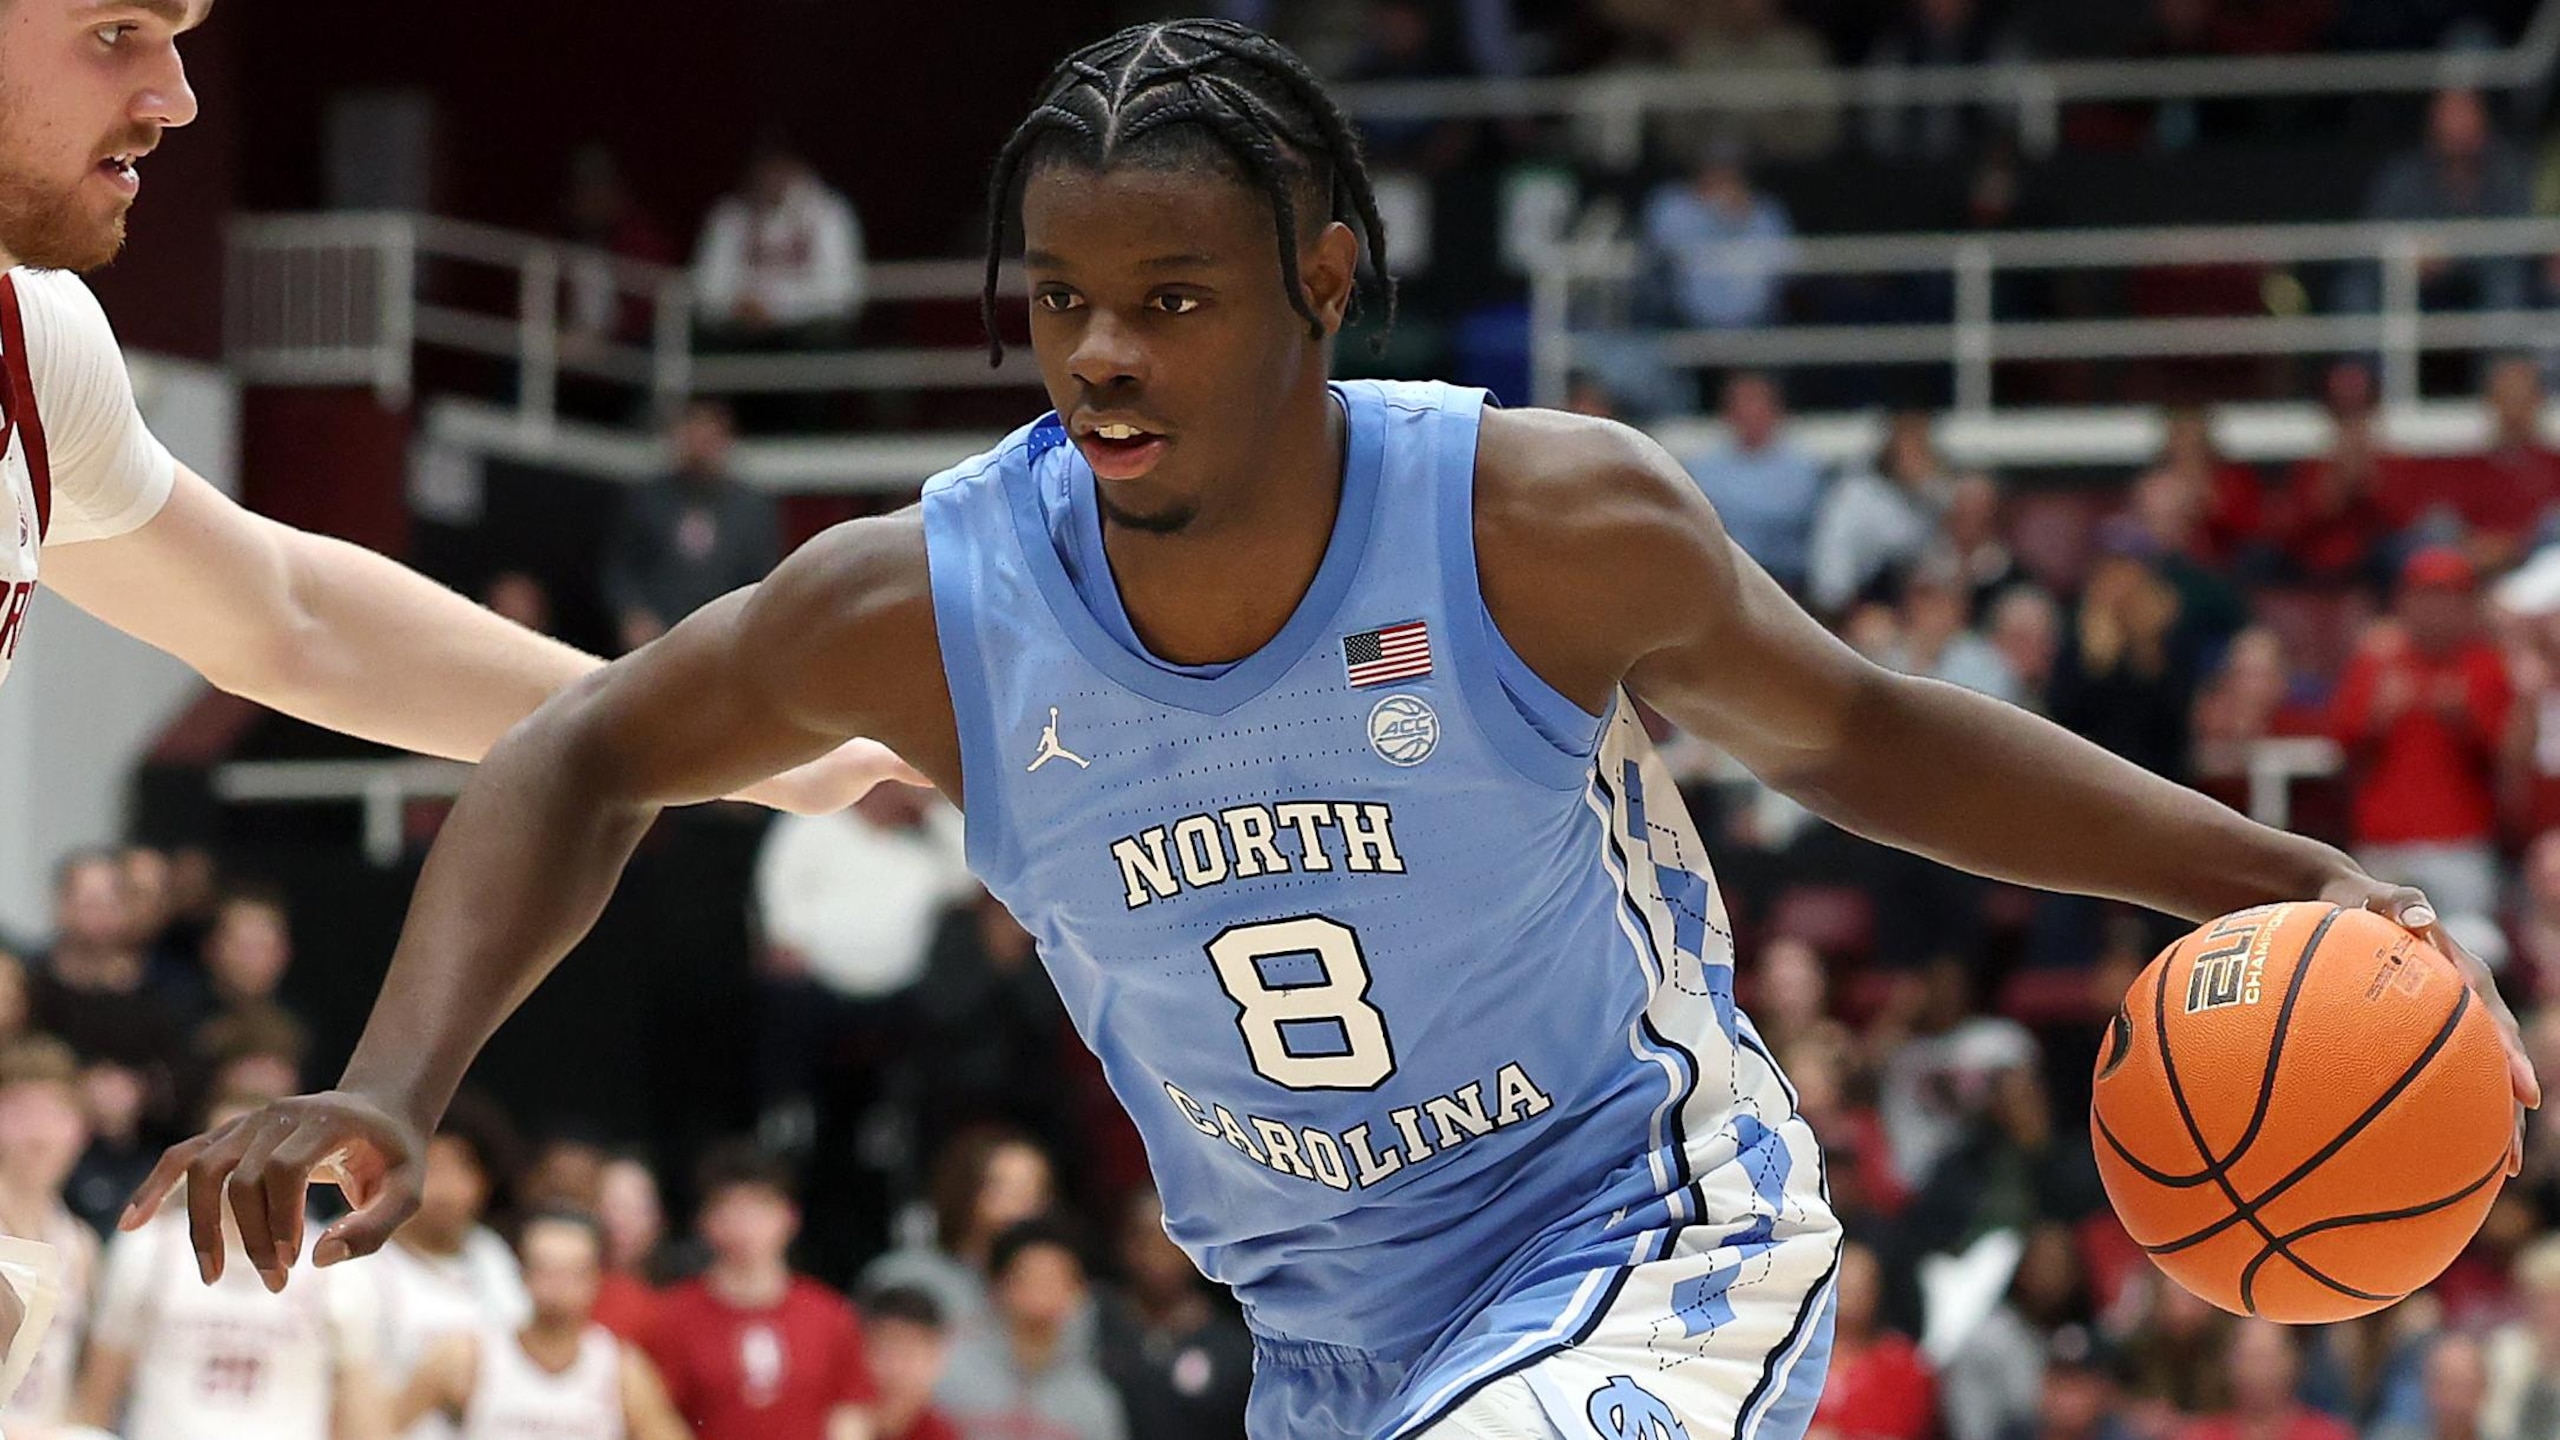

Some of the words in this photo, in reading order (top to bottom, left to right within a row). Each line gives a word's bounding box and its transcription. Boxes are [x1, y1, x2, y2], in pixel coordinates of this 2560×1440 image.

[1110, 799, 1407, 910] NORTH
[1203, 913, 1397, 1092] 8
[1164, 1060, 1553, 1191] CAROLINA
